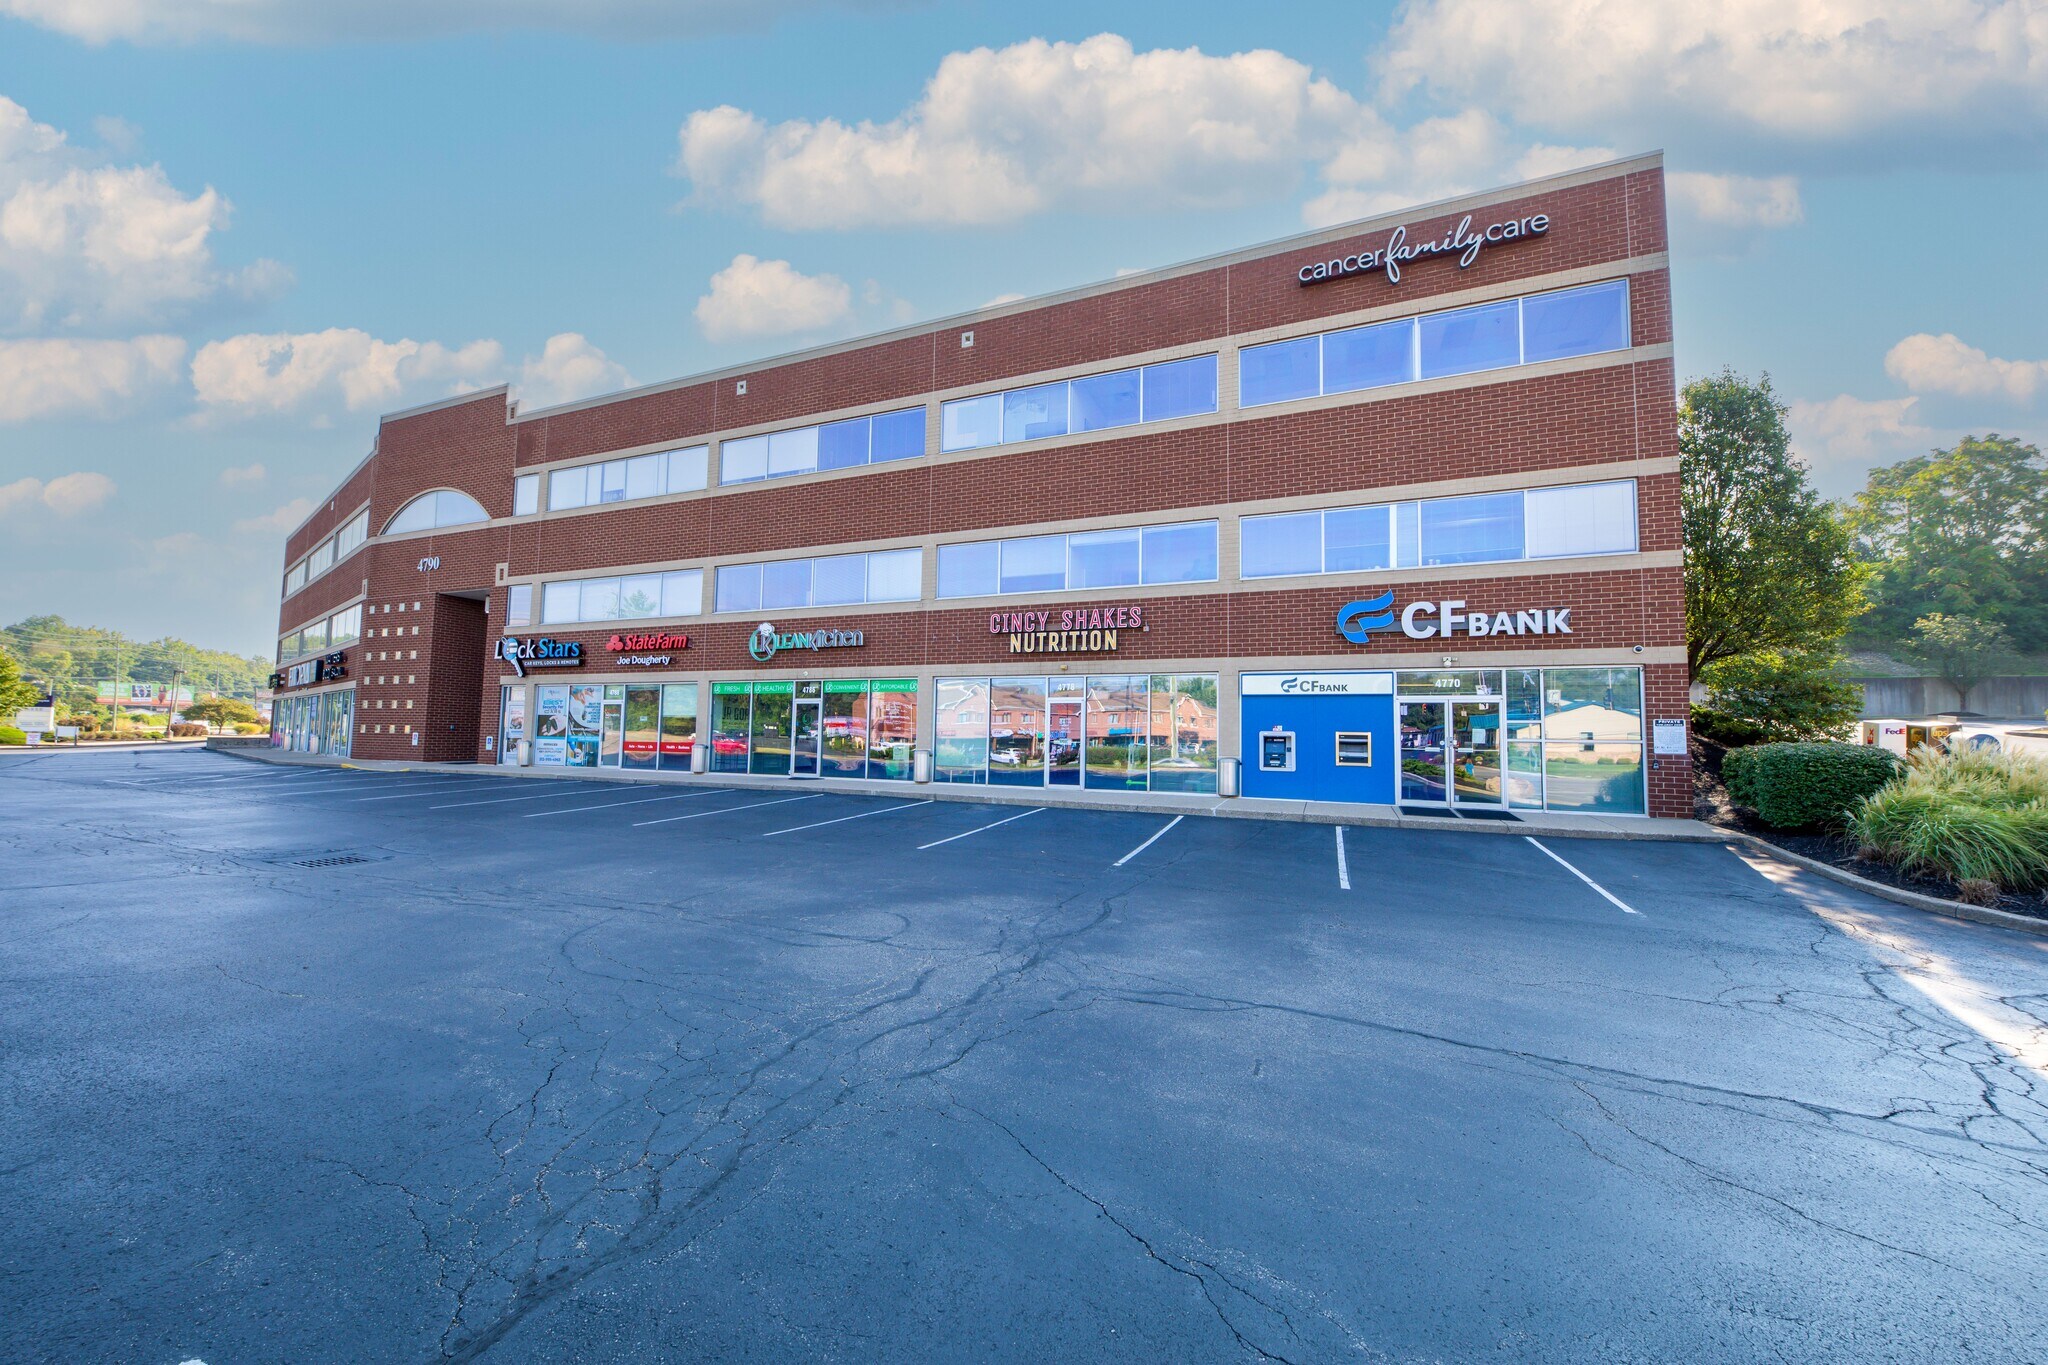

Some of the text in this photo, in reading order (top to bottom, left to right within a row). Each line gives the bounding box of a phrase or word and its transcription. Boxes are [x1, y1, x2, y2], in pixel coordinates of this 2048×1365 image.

[417, 556, 441, 572] 4790
[989, 606, 1142, 633] CINCY SHAKES
[1010, 629, 1117, 653] NUTRITION
[537, 638, 580, 658] Stars
[617, 655, 671, 665] Joe Dougherty
[762, 684, 785, 692] HEALTHY
[1057, 683, 1075, 691] 4778
[1434, 678, 1461, 688] 4770
